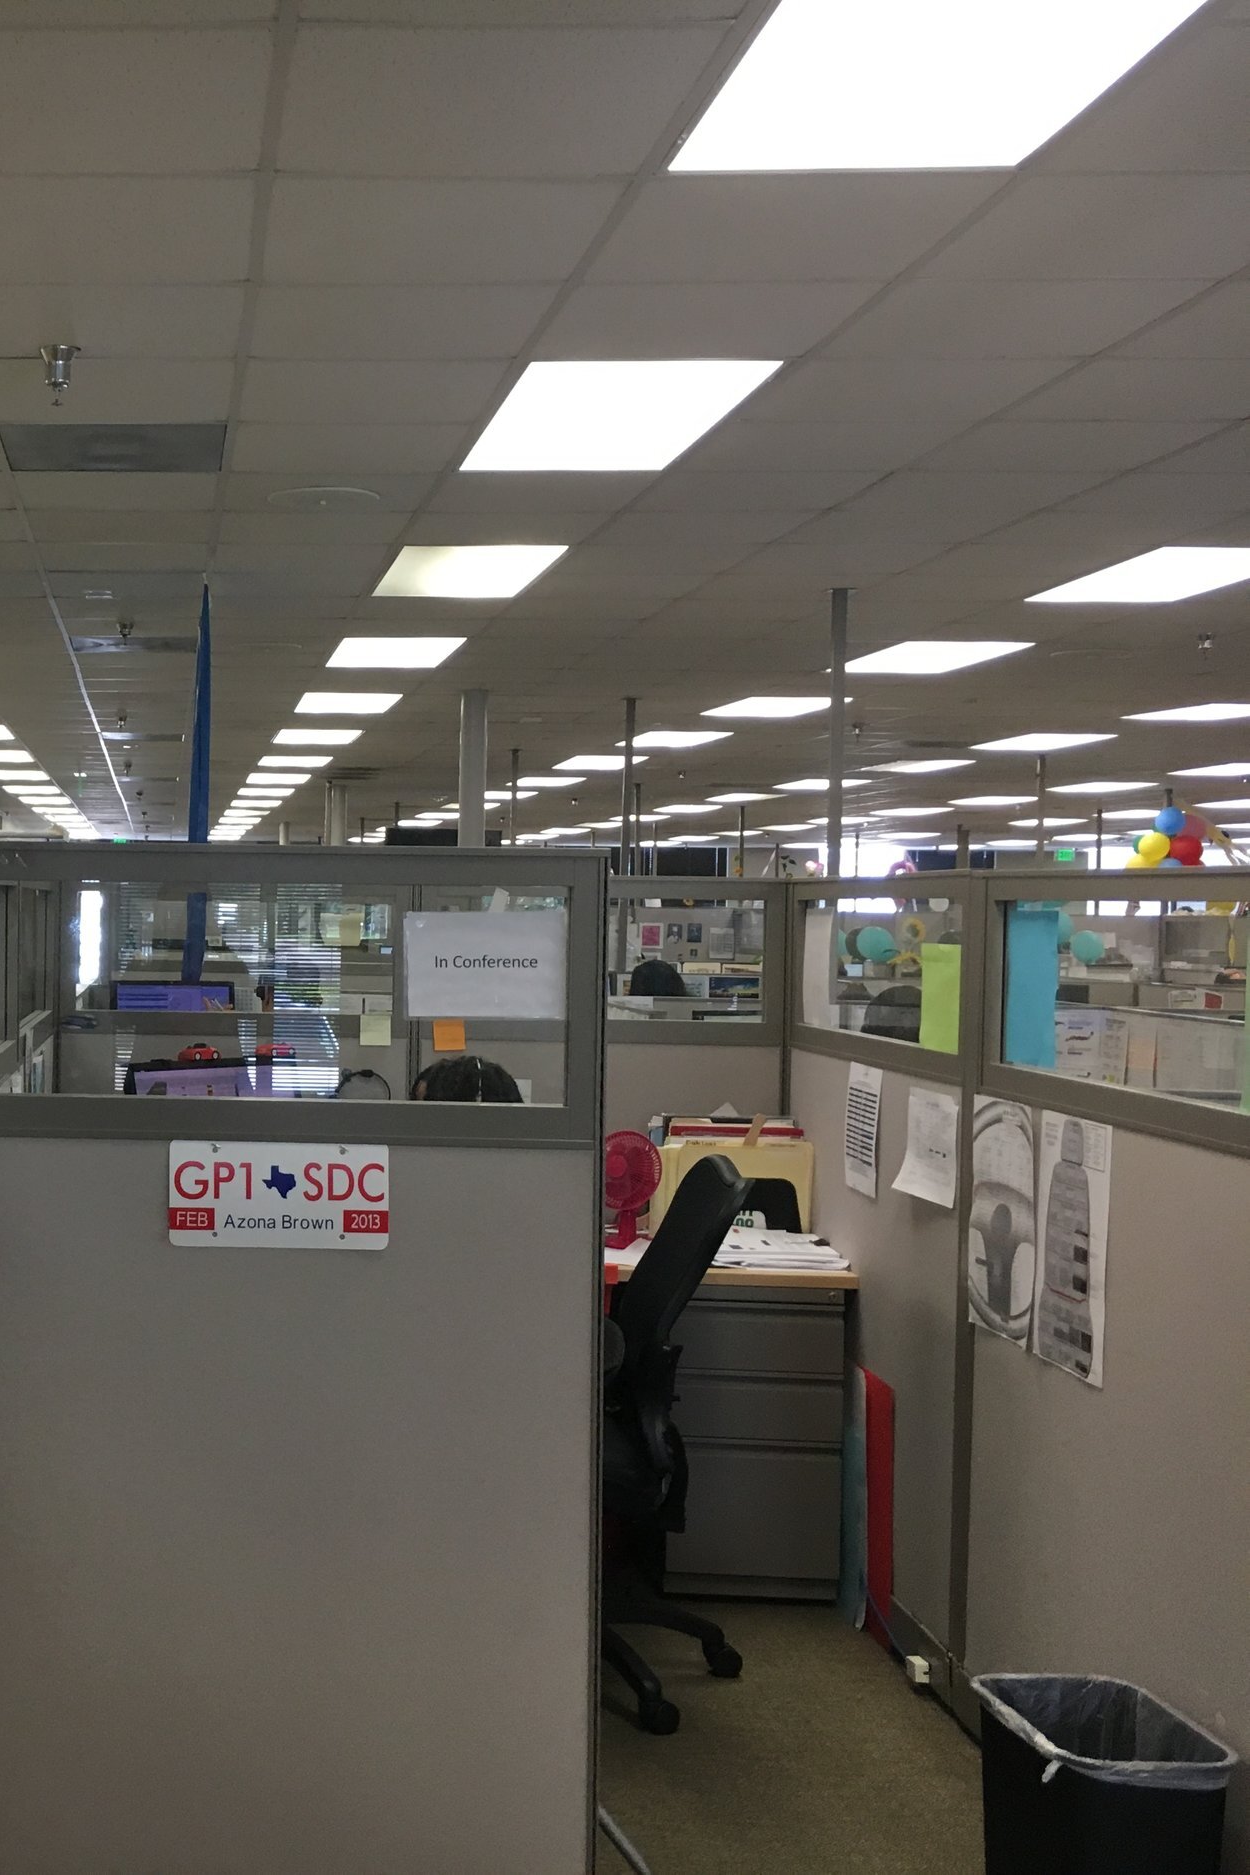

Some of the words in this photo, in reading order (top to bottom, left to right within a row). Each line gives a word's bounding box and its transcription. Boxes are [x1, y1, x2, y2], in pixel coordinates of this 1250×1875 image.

[434, 955, 448, 968] In
[453, 954, 538, 968] Conference
[173, 1160, 252, 1200] GP1
[303, 1162, 385, 1203] SDC
[176, 1211, 209, 1227] FEB
[223, 1214, 276, 1230] Azona
[282, 1215, 334, 1230] Brown
[350, 1214, 381, 1230] 2013
